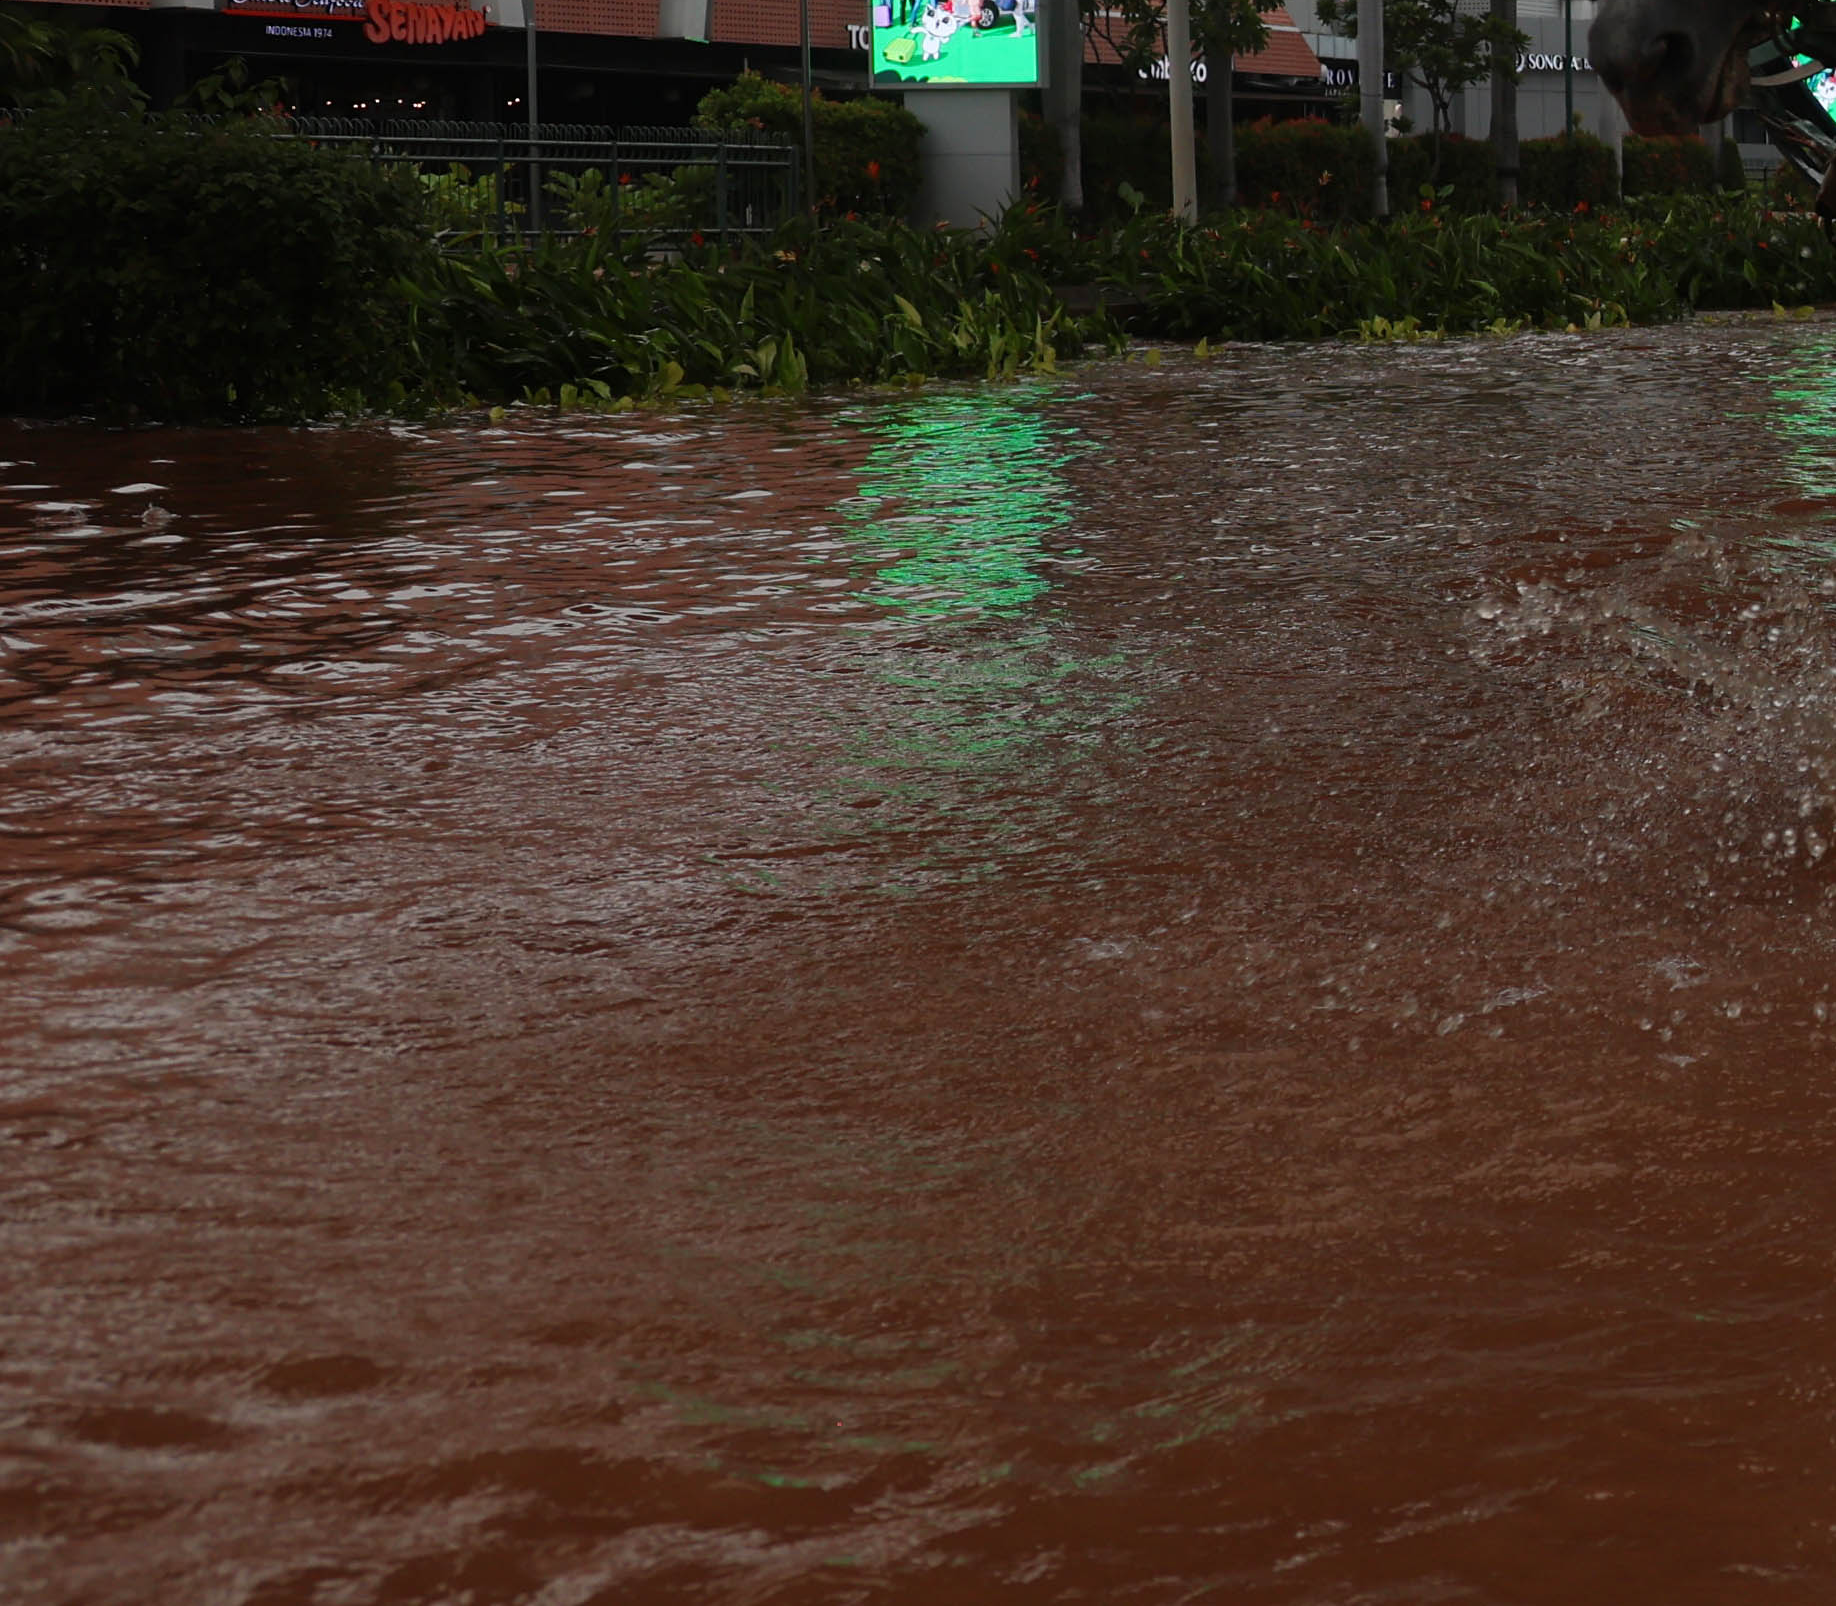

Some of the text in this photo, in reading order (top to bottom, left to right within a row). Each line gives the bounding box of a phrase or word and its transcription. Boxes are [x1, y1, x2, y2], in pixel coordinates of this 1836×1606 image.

[265, 25, 333, 39] INDONESIA 1974
[1528, 54, 1563, 71] SONG
